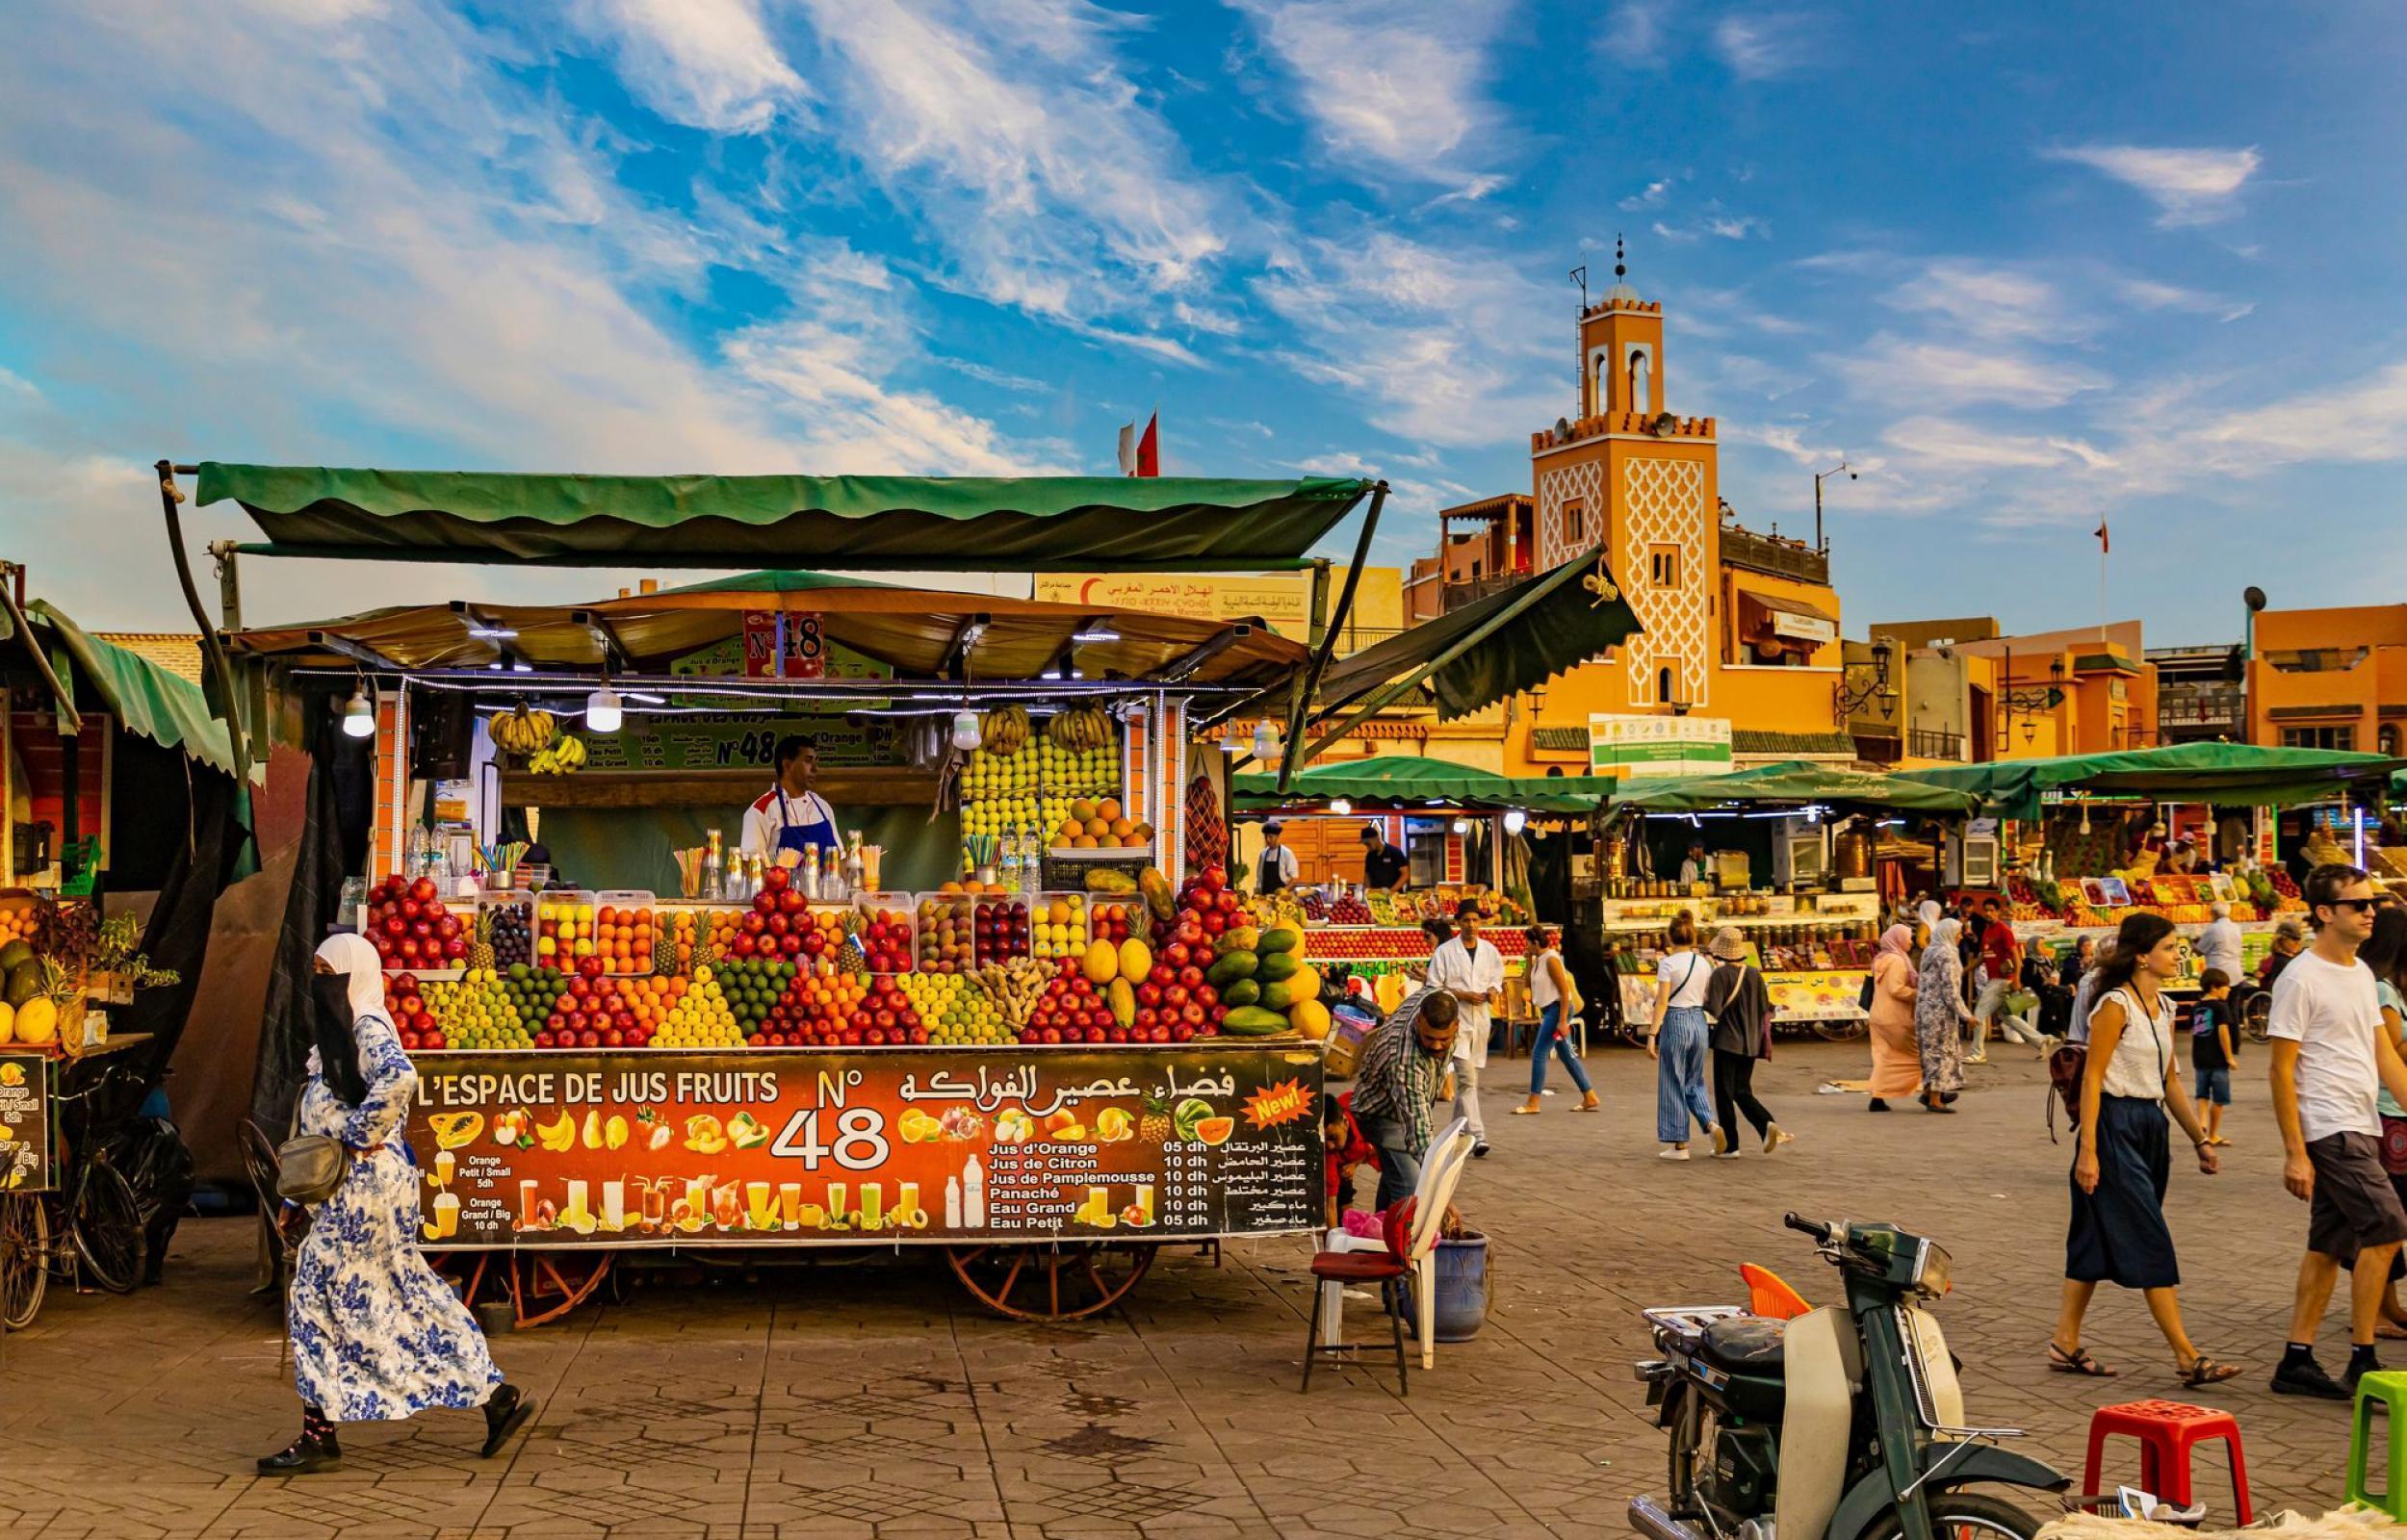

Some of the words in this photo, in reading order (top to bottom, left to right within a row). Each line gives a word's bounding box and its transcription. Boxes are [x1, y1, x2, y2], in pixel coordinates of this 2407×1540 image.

[1107, 582, 1144, 594] المغربي
[1184, 585, 1213, 597] الهلال
[716, 740, 740, 764] N°
[740, 731, 776, 764] 48
[818, 1068, 863, 1108] N°
[1155, 1065, 1236, 1099] فضاء
[418, 1073, 556, 1106] L'ESPACE
[565, 1072, 603, 1103] DE
[611, 1072, 668, 1103] JUS
[677, 1071, 779, 1103] FRUITS
[1022, 1075, 1140, 1116] عصير
[14, 1098, 39, 1111] Small
[1255, 1089, 1302, 1121] New!
[4, 1111, 22, 1123] 5dh
[770, 1108, 890, 1171] 48
[989, 1143, 1019, 1155] Jus
[1023, 1142, 1098, 1156] d'Orange
[1163, 1142, 1183, 1152] 05
[1187, 1141, 1208, 1152] dh
[1220, 1141, 1269, 1154] البرتقال
[1269, 1142, 1307, 1153] عصير
[23, 1152, 39, 1169] Big
[469, 1155, 502, 1167] Orange
[989, 1158, 1019, 1170] Jus
[1023, 1158, 1044, 1169] de
[1048, 1157, 1098, 1169] Citron
[1164, 1156, 1183, 1168] 10
[1187, 1155, 1208, 1168] dh
[1217, 1156, 1269, 1169] الحامض
[1269, 1157, 1307, 1168] عصير
[459, 1168, 480, 1177] Petit
[486, 1167, 511, 1176] Small
[1164, 1170, 1183, 1182] 10
[1187, 1169, 1208, 1182] dh
[1211, 1170, 1269, 1184] البليموس
[1269, 1171, 1307, 1183] عصير
[477, 1178, 494, 1189] 5dh
[989, 1173, 1017, 1186] Jus
[1021, 1173, 1039, 1185] de
[1043, 1171, 1155, 1186] Pamplemousse
[990, 1187, 1060, 1199] Panaché
[1164, 1185, 1183, 1196] 10
[1187, 1184, 1208, 1196] dh
[1224, 1185, 1269, 1195] مختلط
[1269, 1186, 1307, 1196] عصير
[470, 1197, 503, 1209] Orange
[990, 1202, 1022, 1214] Eau
[1025, 1201, 1075, 1214] Grand
[1164, 1199, 1183, 1211] 10
[1187, 1199, 1208, 1211] dh
[1248, 1200, 1286, 1212] كبير
[1288, 1200, 1307, 1211] ماء
[462, 1210, 489, 1219] Grand
[495, 1209, 511, 1221] Big
[1163, 1215, 1183, 1225] 05
[1187, 1214, 1208, 1225] dh
[1251, 1214, 1287, 1226] صغير
[1288, 1215, 1307, 1224] ماء
[475, 1220, 486, 1230] 10
[486, 1220, 499, 1230] dh
[990, 1218, 1022, 1228] Eau
[1025, 1217, 1064, 1228] Petit
